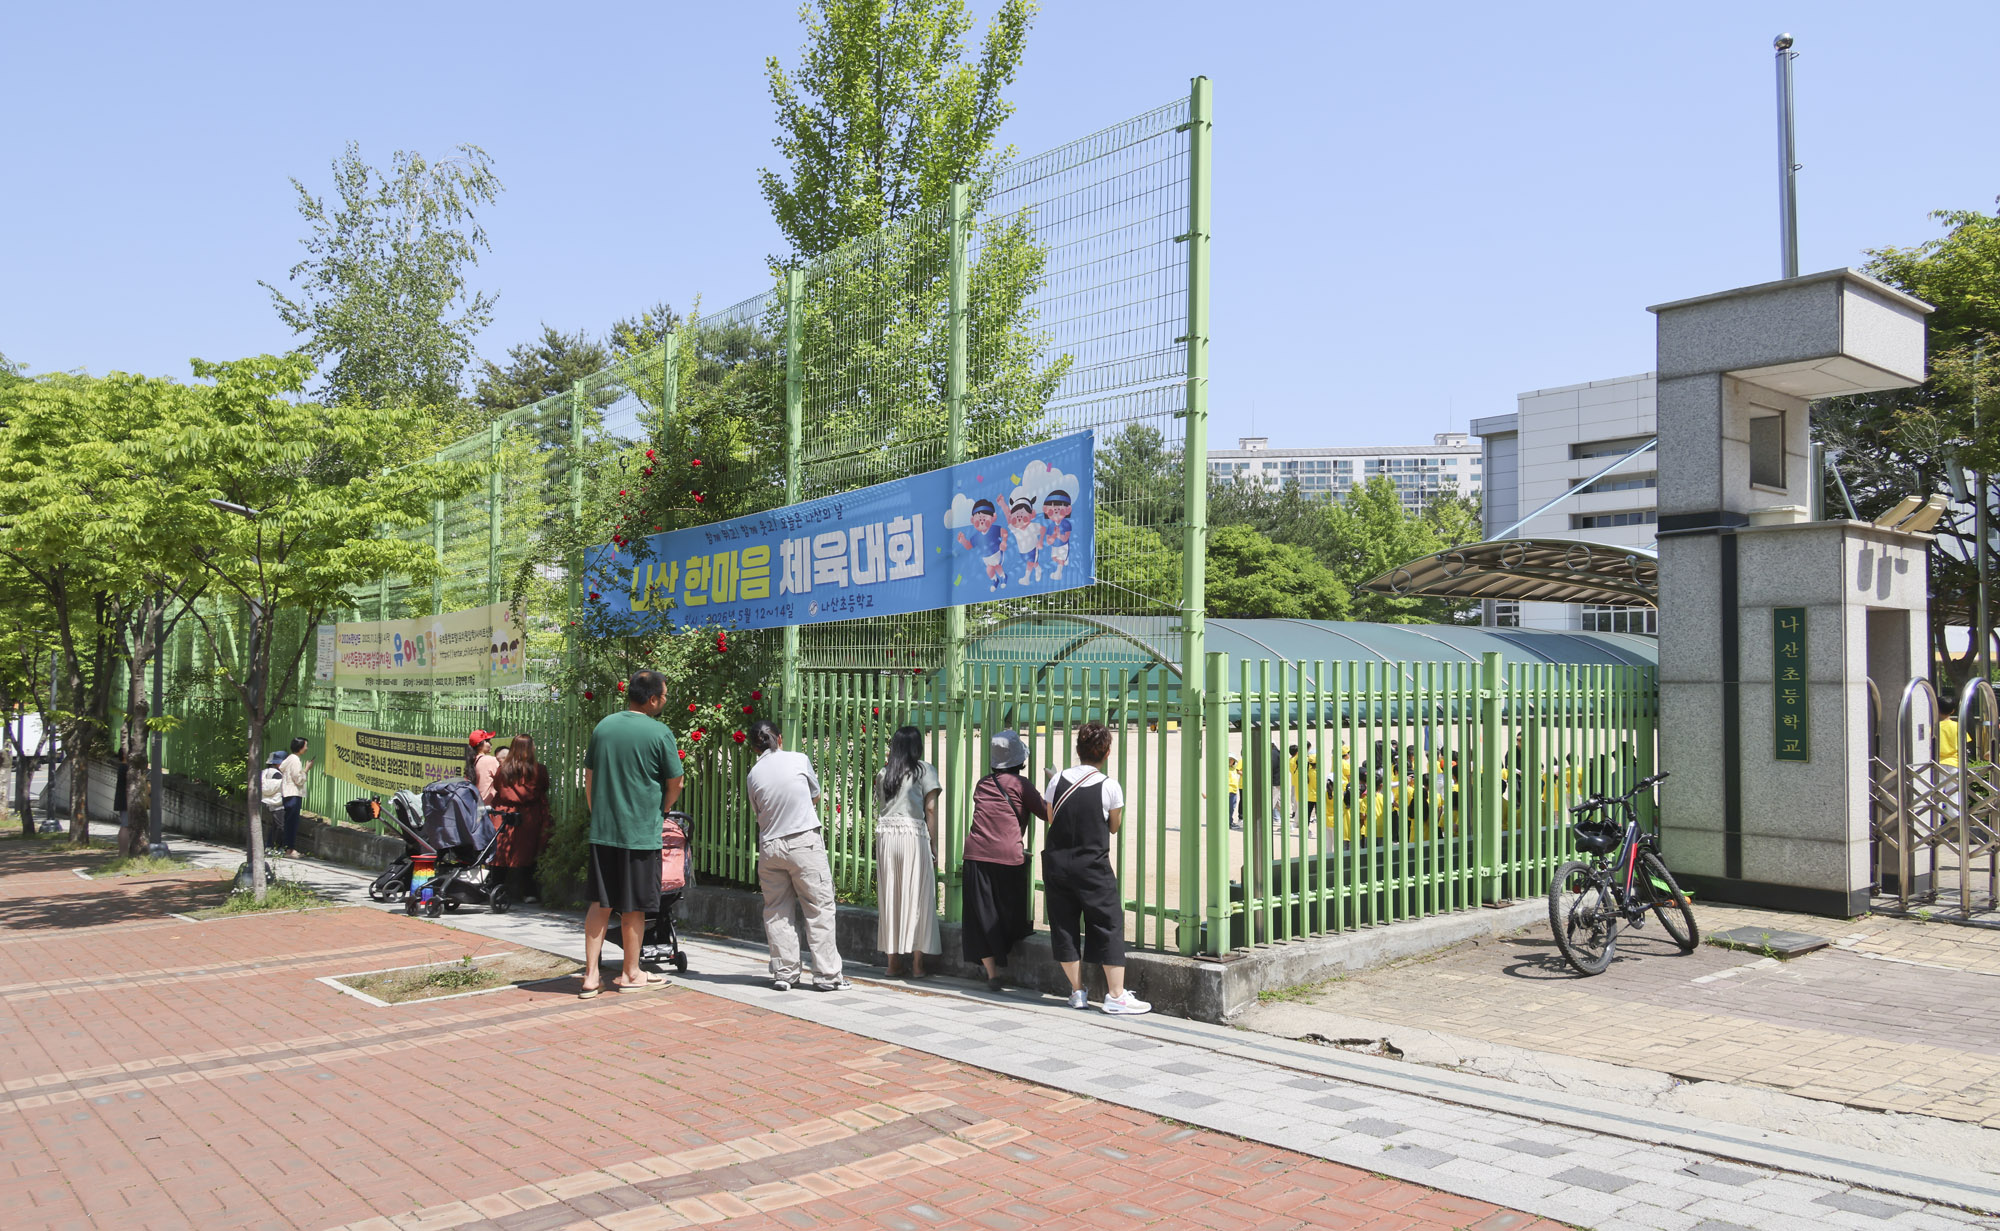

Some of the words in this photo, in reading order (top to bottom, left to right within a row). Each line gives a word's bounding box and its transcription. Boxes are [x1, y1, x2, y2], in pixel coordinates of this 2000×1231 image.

[705, 531, 721, 544] 함께
[721, 528, 740, 539] 뛰고!
[741, 525, 758, 538] 함께
[759, 520, 778, 536] 웃고!
[781, 512, 803, 531] 오늘은
[805, 508, 831, 523] 나산의
[834, 503, 843, 520] 날
[630, 560, 679, 612] 나산
[683, 545, 771, 606] 한마음
[779, 513, 925, 596] 체육대회
[706, 610, 735, 623] 2026년
[738, 608, 751, 624] 5월
[754, 603, 794, 619] 12~14일
[821, 593, 874, 613] 나산초등학교
[341, 651, 392, 669] 나산초등학교병설유치원
[393, 631, 437, 668] 유아모집
[1780, 616, 1801, 753] 나산초등학교
[351, 750, 370, 769] 대한민국
[371, 754, 387, 773] 청소년
[387, 757, 410, 777] 창업경진
[425, 763, 443, 781] 우수상
